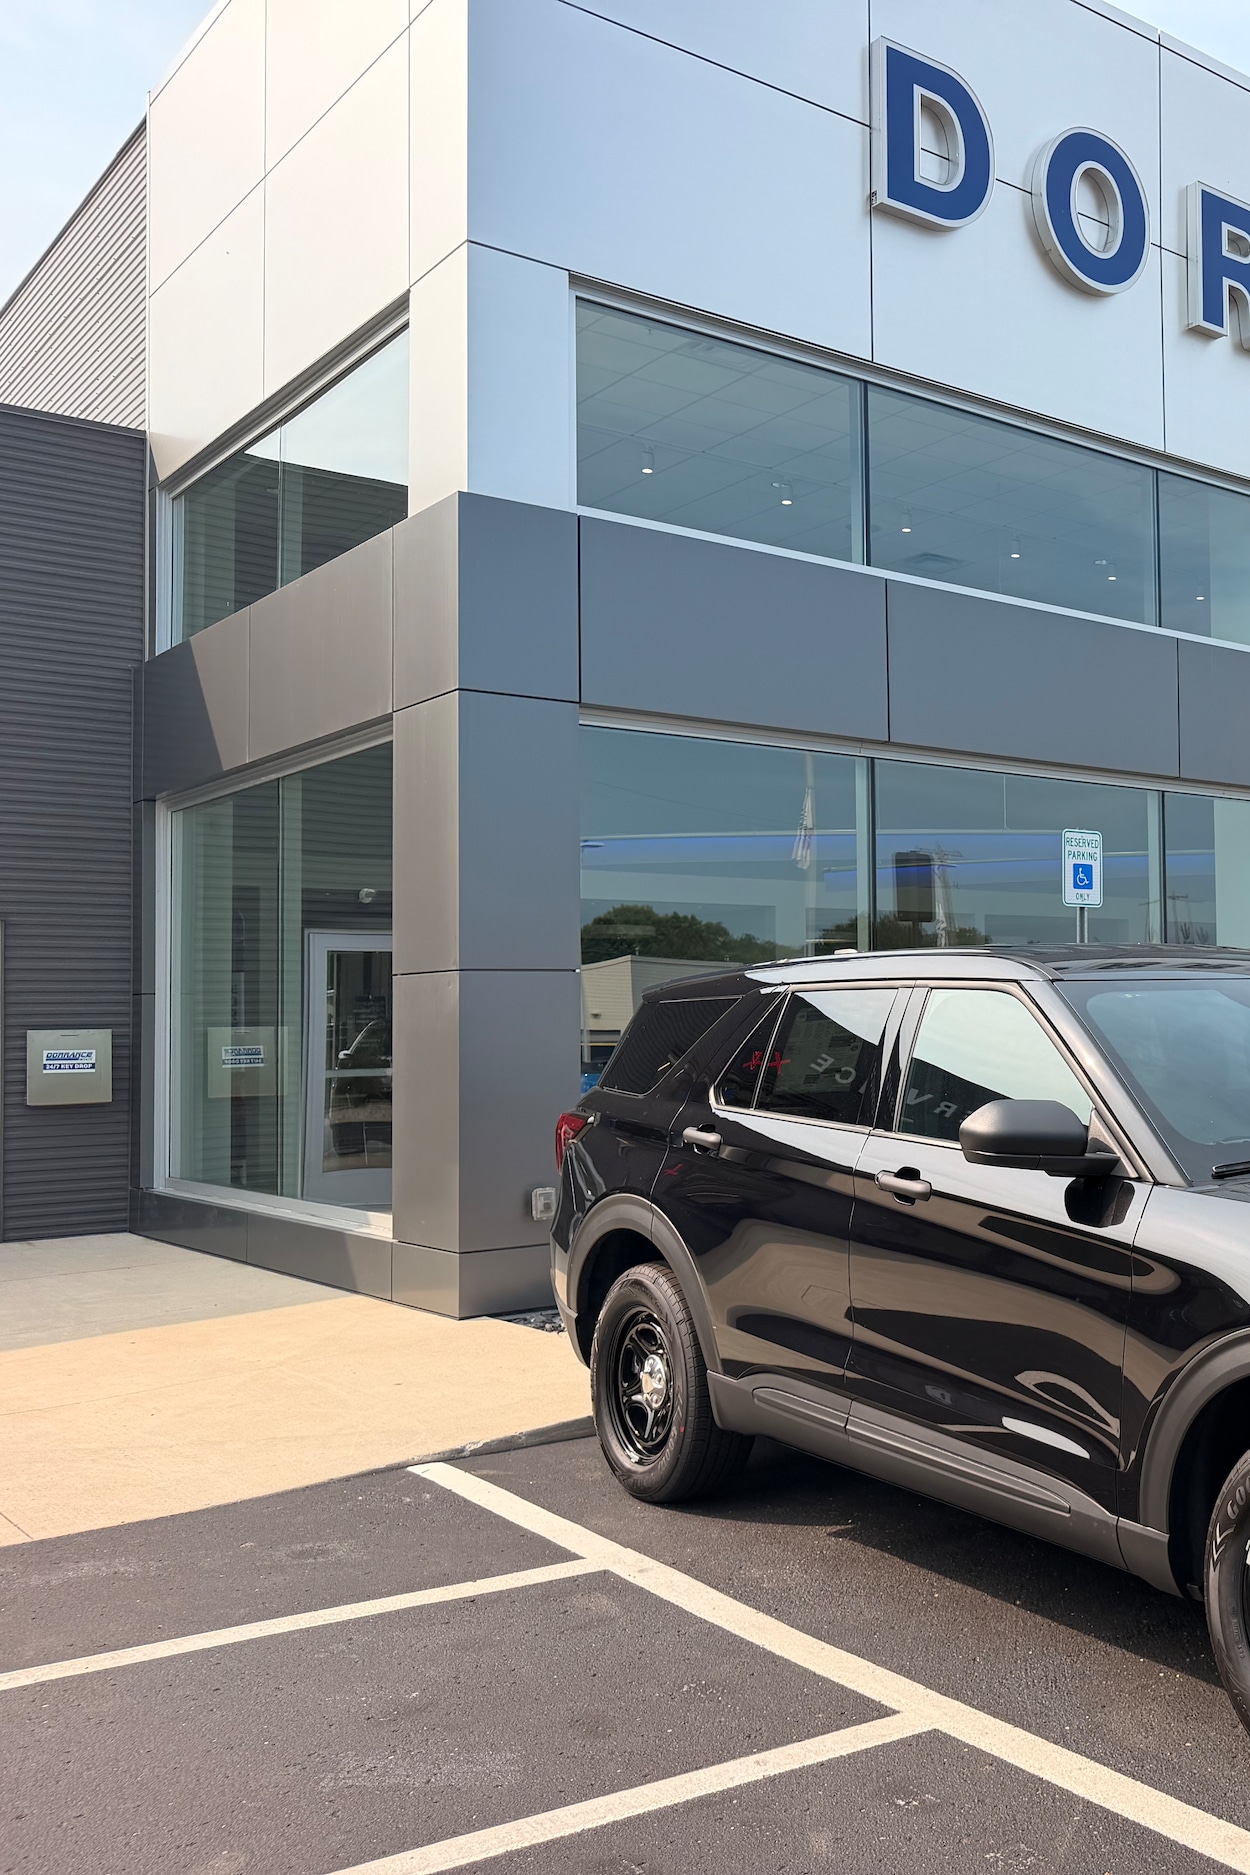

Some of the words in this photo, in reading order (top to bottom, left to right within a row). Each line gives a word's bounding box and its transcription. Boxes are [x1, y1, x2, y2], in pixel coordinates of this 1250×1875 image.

[1065, 836, 1099, 849] RESERVED
[1067, 850, 1098, 862] PARKING
[1075, 892, 1091, 902] ONLY
